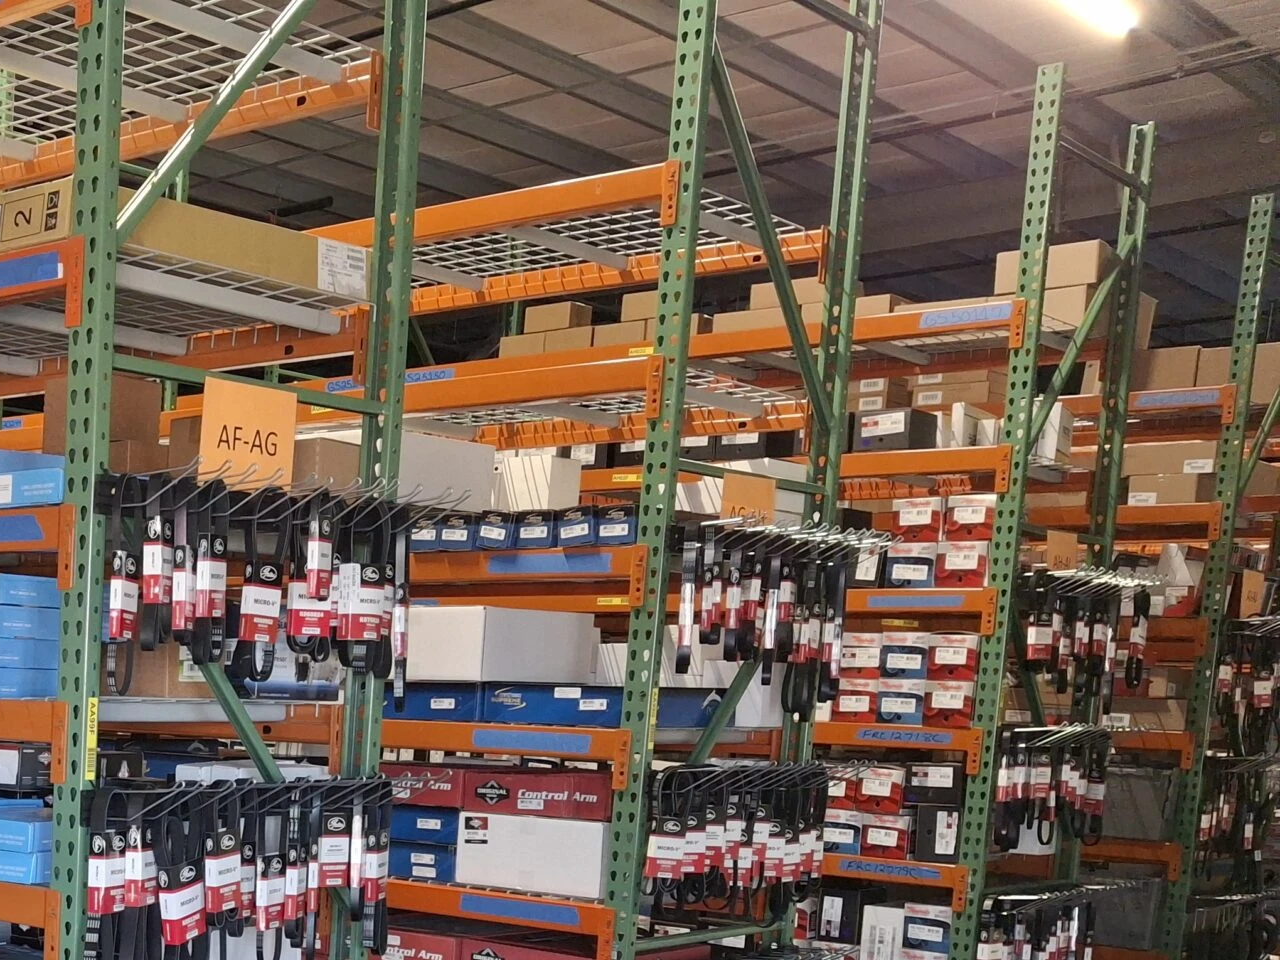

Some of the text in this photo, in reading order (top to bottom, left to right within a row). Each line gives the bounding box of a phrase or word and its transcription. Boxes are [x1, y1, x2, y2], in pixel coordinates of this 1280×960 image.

[14, 207, 32, 227] 2
[216, 424, 279, 457] AF-AG
[428, 781, 452, 791] Arm
[476, 788, 508, 796] ORIGINAL
[517, 788, 598, 803] Control Arm
